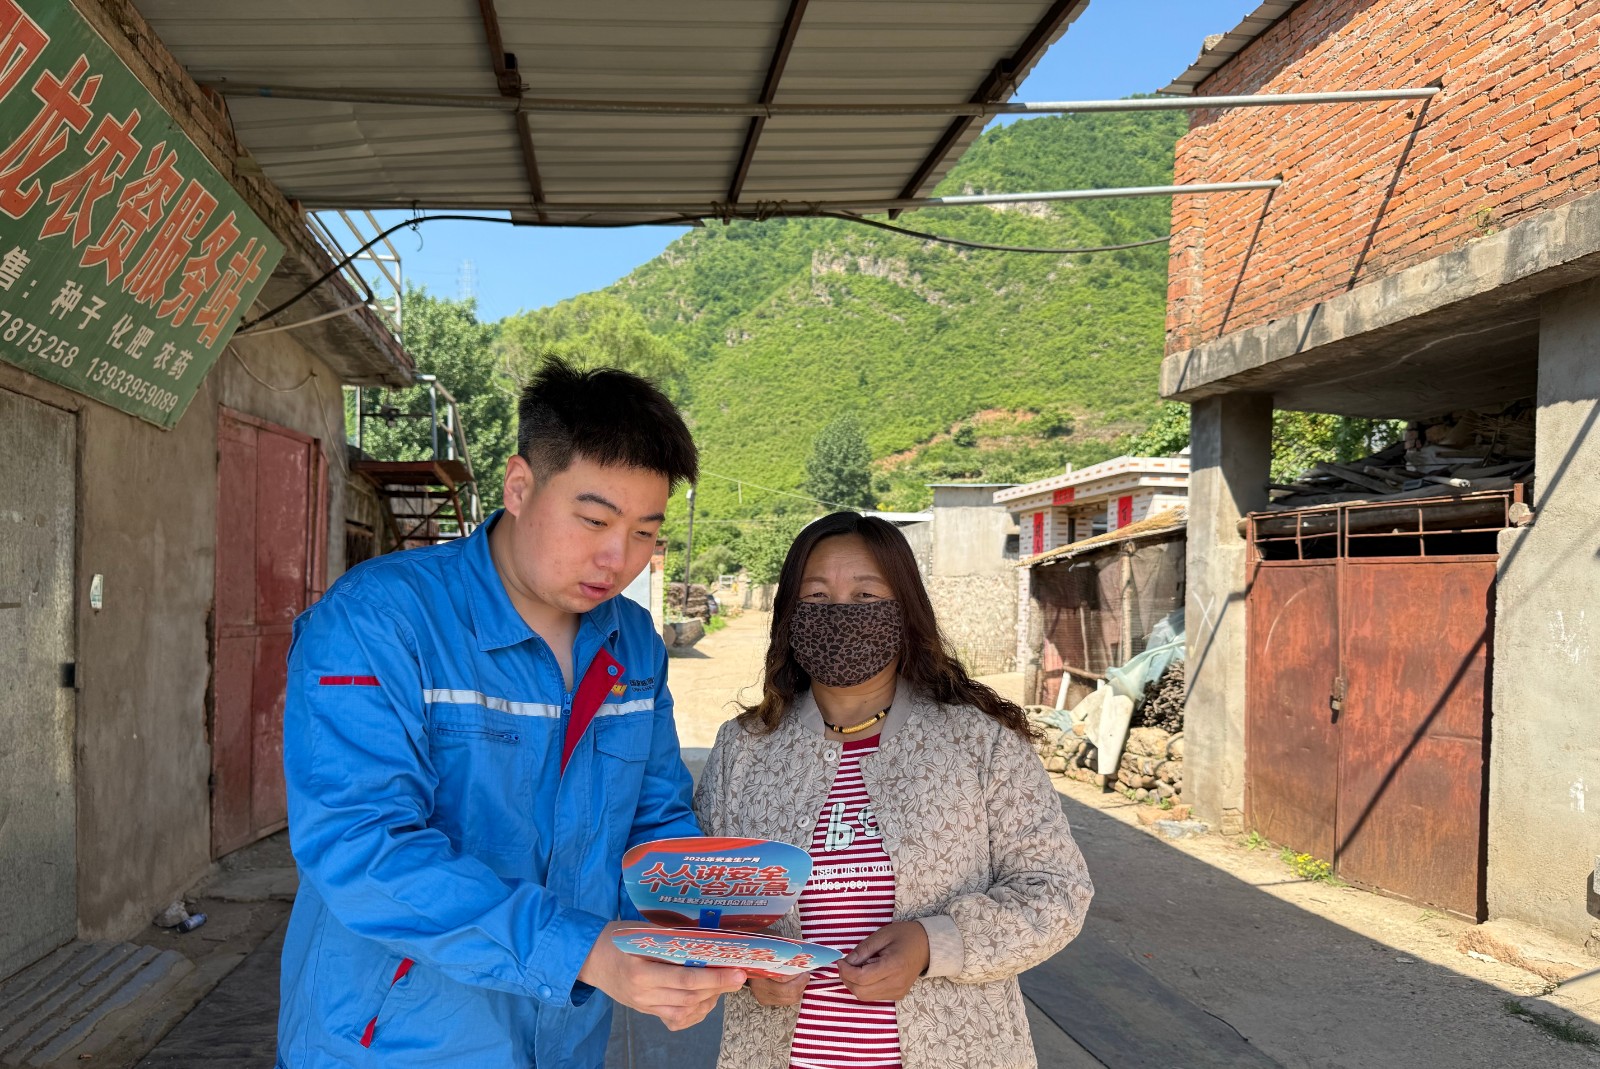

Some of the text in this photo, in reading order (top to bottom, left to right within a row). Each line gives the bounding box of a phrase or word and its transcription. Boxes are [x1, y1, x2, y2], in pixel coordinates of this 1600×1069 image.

[50, 280, 107, 330] 种子
[106, 313, 155, 360] 化肥
[153, 341, 193, 380] 农药
[86, 357, 178, 413] 13933959089
[639, 877, 796, 897] 个个会应急
[642, 862, 790, 882] 人人讲安全
